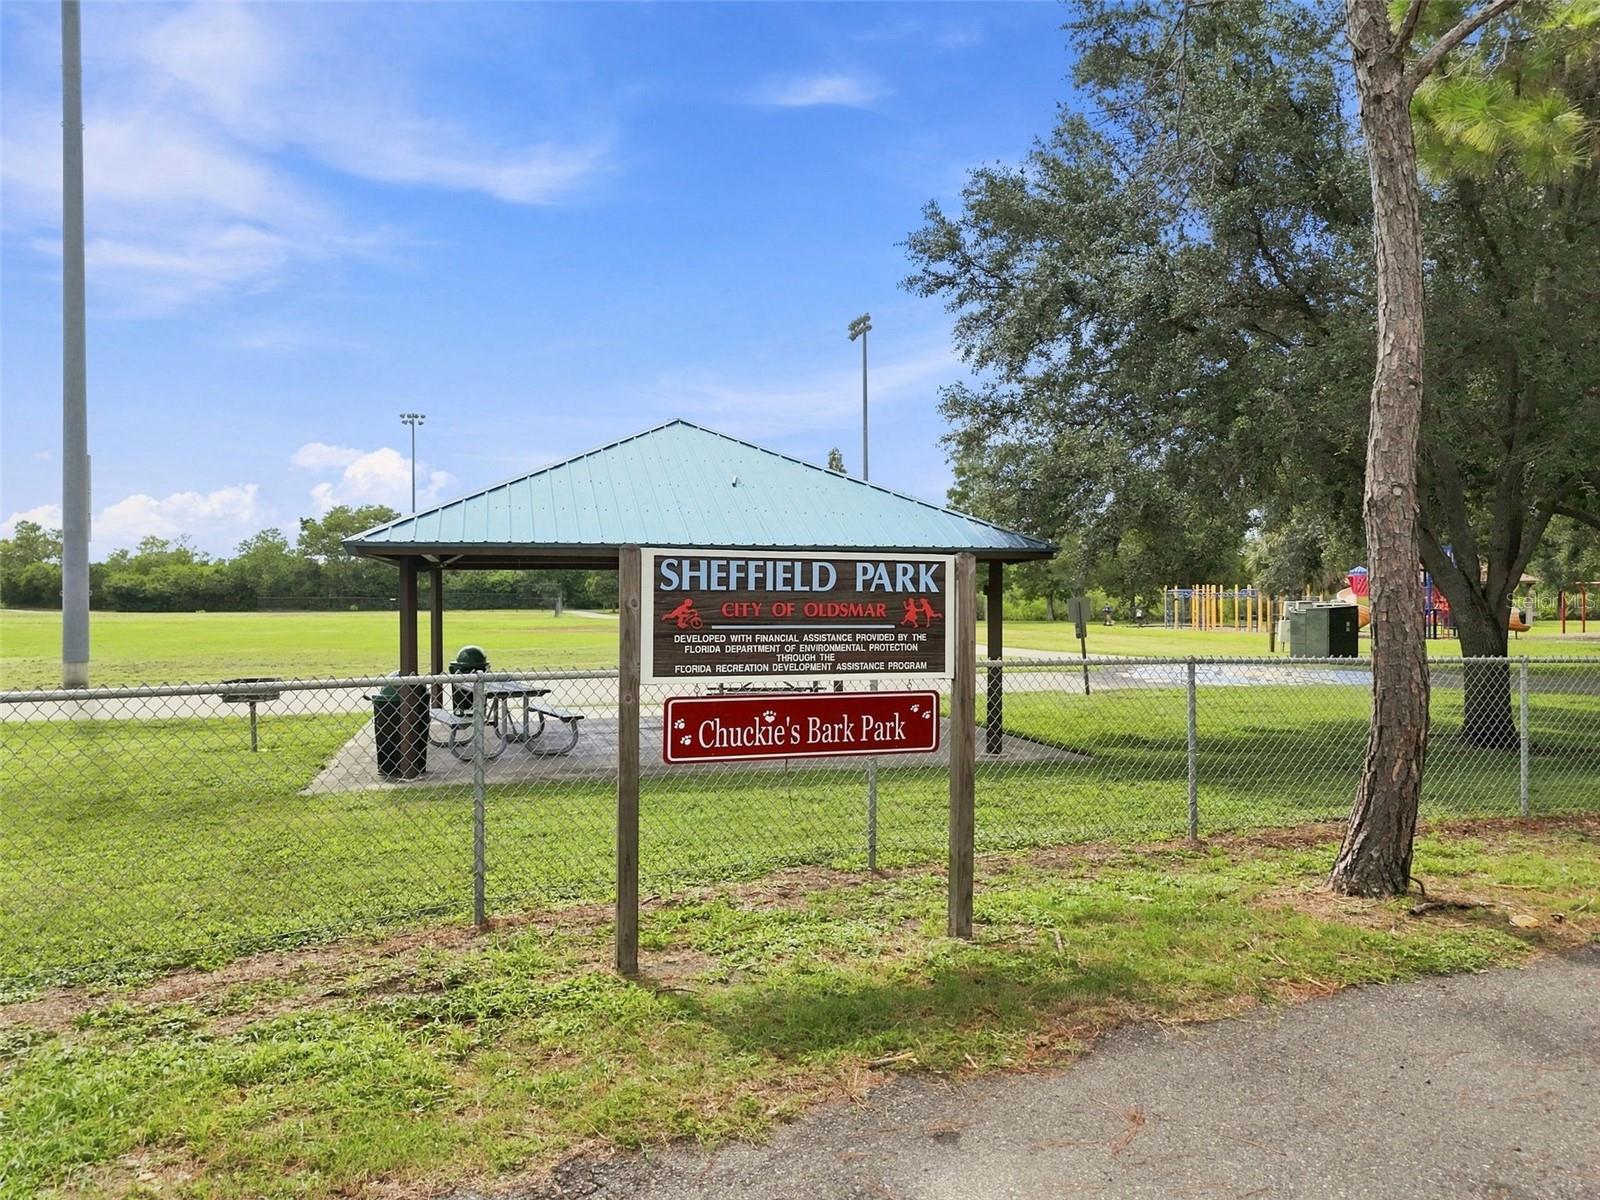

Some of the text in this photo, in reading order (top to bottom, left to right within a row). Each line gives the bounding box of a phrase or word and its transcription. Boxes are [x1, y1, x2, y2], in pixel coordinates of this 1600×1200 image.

[659, 558, 940, 593] SHEFFIELD PARK
[721, 602, 887, 618] CITY OF OLDSMAR
[673, 633, 927, 643] DEVELOPED WITH FINANCIAL ASSISTANCE PROVIDED BY THE
[684, 643, 918, 654] FLORIDA DEPARTMENT OF ENVIRONMENTAL PROTECTION
[776, 653, 835, 662] THROUGH THE
[674, 661, 927, 674] FLORIDA RECREATION DEVELOPMENT ASSISTANCE PROGRAM
[698, 712, 906, 748] Chuckie's Bark Park
